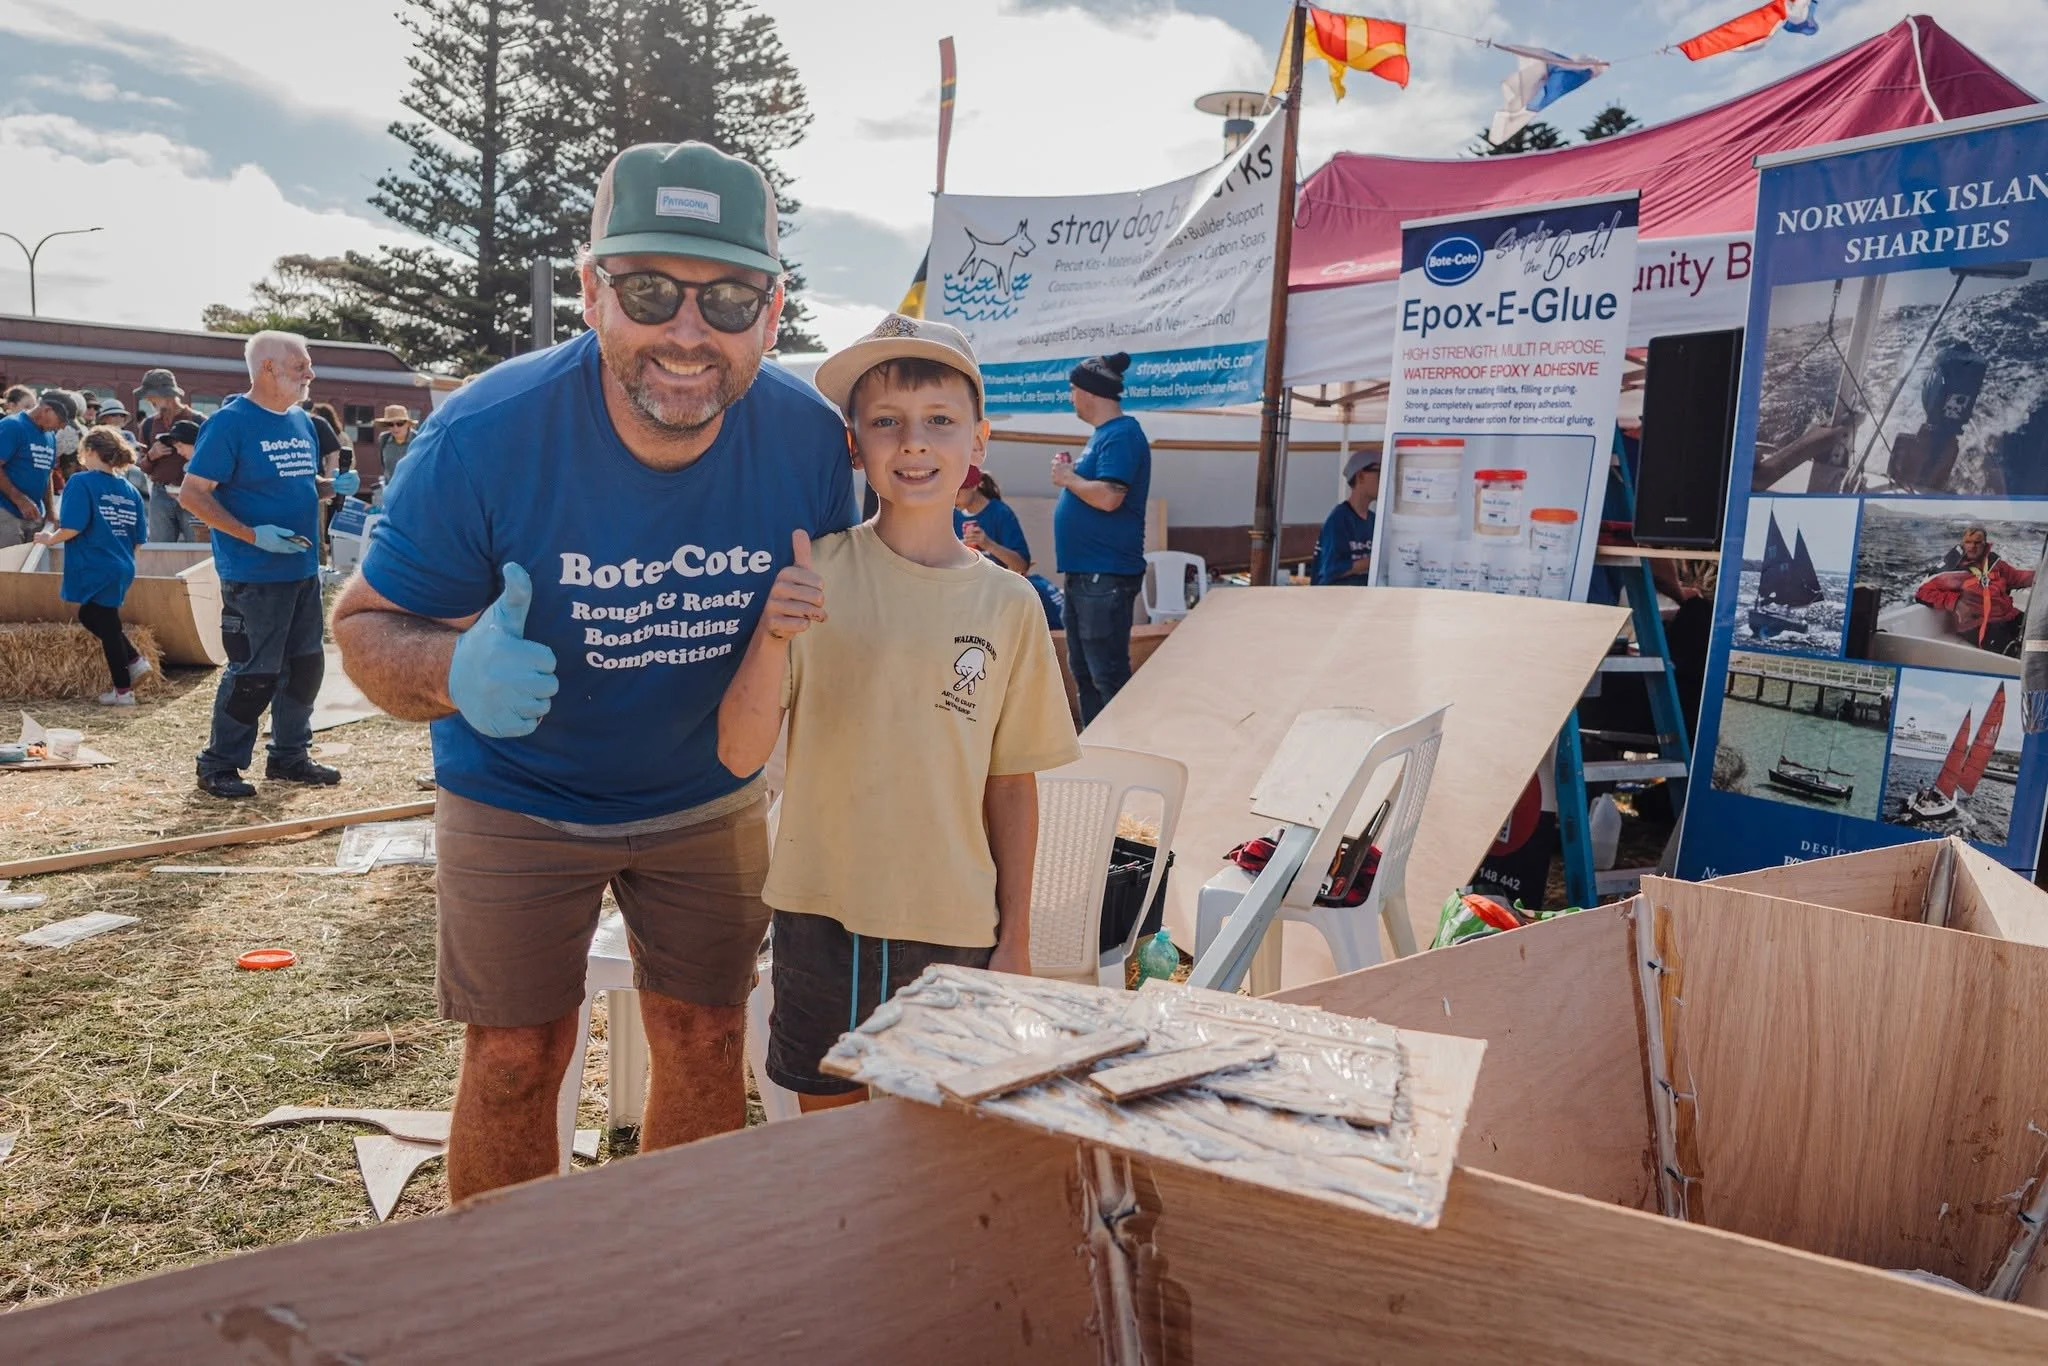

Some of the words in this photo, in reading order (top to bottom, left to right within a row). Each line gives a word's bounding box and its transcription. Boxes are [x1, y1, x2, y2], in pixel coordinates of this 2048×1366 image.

[1187, 216, 1225, 240] Builder
[1225, 202, 1265, 228] Support
[1776, 188, 1938, 235] NORWALK
[1047, 214, 1119, 254] stray
[1122, 203, 1165, 247] dog
[1524, 259, 1542, 275] the
[1543, 210, 1622, 281] Best!
[1844, 219, 2010, 264] SHARPIES
[1428, 253, 1477, 269] Bote-Cote
[1403, 287, 1617, 338] Epox-E-Glue
[1071, 325, 1105, 343] Designs
[1403, 346, 1429, 361] HIGH
[1501, 342, 1536, 357] MULTI
[1539, 339, 1607, 357] PURPOSE,
[1404, 366, 1487, 381] WATERPROOF
[1490, 364, 1530, 379] EPOXY
[1533, 362, 1600, 377] ADHESIVE
[1151, 384, 1173, 397] Based
[1406, 387, 1420, 396] Use
[1421, 387, 1429, 395] in
[1430, 387, 1453, 397] places
[1455, 386, 1466, 395] for
[1405, 401, 1430, 412] Strong,
[1432, 401, 1473, 411] completely
[1514, 401, 1536, 411] epoxy
[1404, 415, 1425, 424] Faster
[1427, 416, 1451, 426] curing
[1452, 415, 1485, 424] hardener
[1509, 415, 1521, 424] for
[1566, 414, 1596, 427] gluing.
[559, 544, 772, 589] Bote-Cote
[571, 600, 654, 624] Rough
[656, 592, 678, 610] &
[682, 590, 755, 611] Ready
[584, 618, 740, 647] Boatbuilding
[954, 635, 986, 647] WALKING
[586, 643, 732, 670] Competition
[1500, 875, 1521, 890] 442
